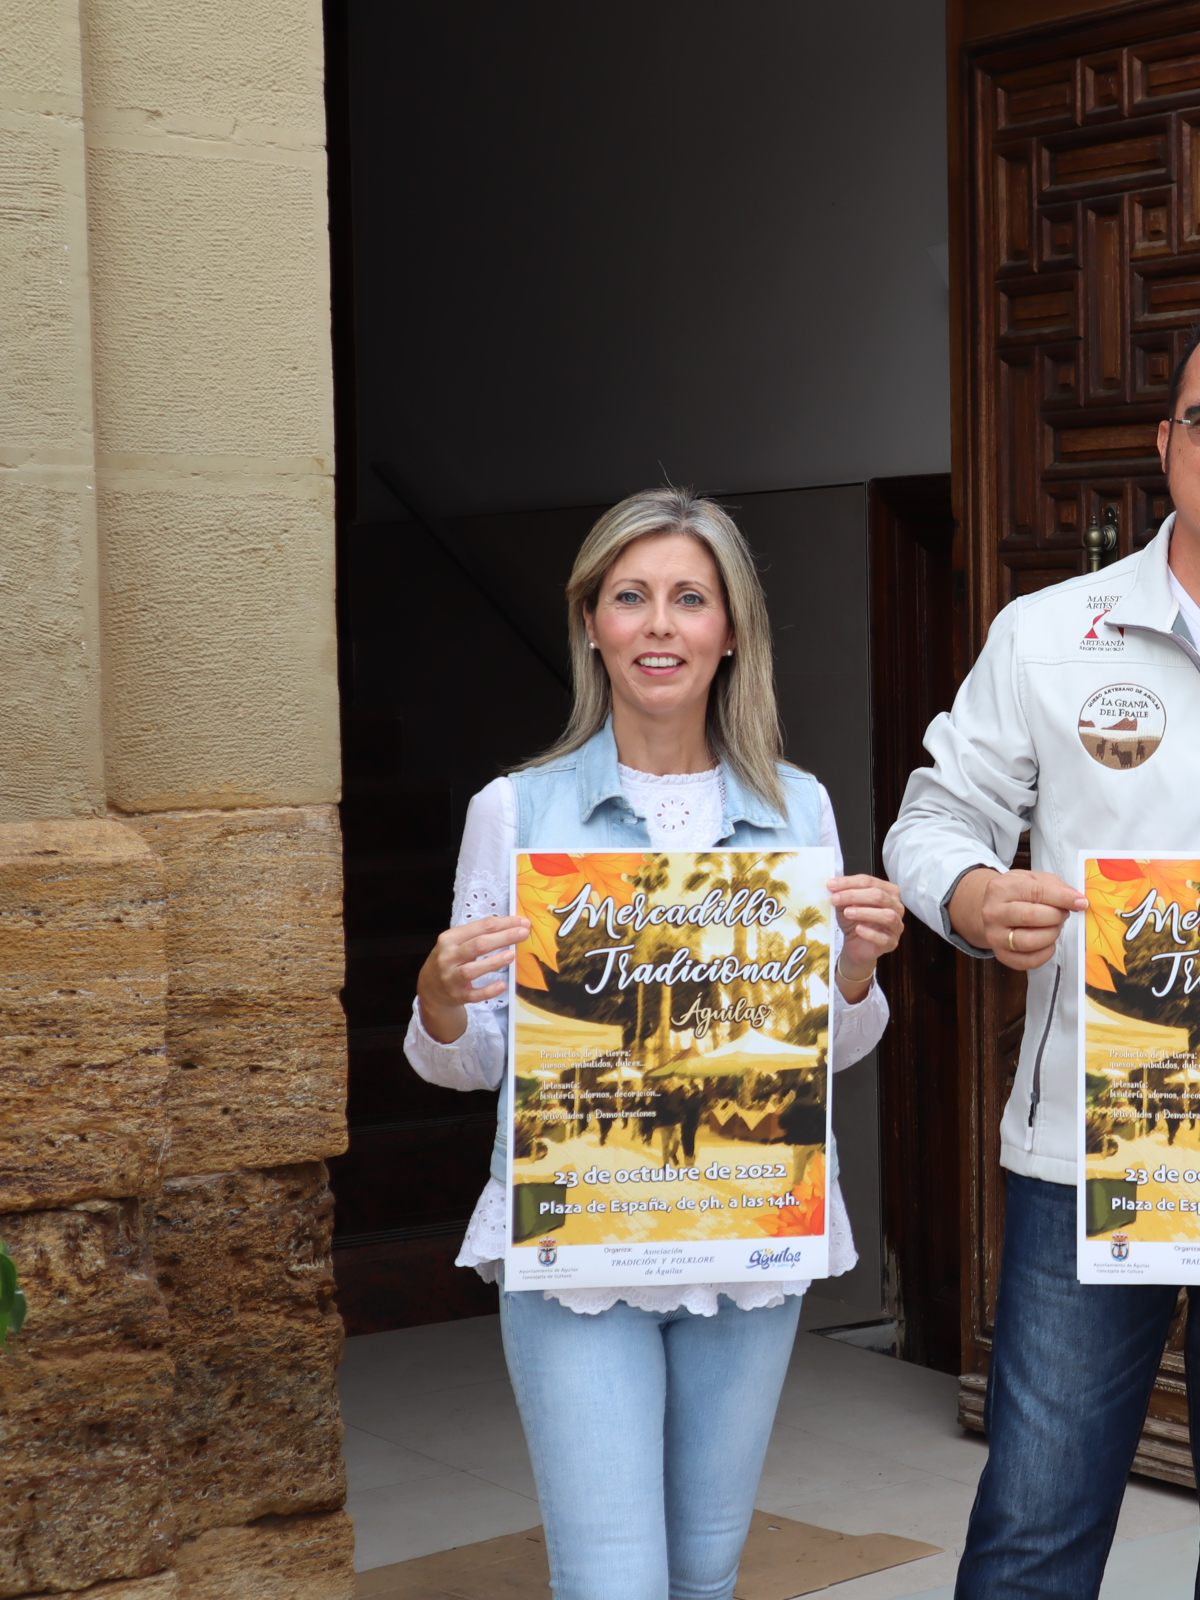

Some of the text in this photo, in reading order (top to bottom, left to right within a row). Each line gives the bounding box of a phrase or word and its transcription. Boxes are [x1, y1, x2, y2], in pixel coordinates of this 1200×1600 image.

[554, 882, 786, 939] Mercadillo
[584, 944, 808, 994] Tradicional
[671, 992, 771, 1038] Águilas
[540, 1050, 580, 1059] Productos
[583, 1049, 592, 1057] de
[595, 1049, 602, 1057] la
[1109, 1050, 1148, 1059] Productos
[1151, 1050, 1160, 1059] de
[1162, 1050, 1170, 1059] la
[587, 1113, 592, 1122] y
[1155, 1112, 1160, 1121] y
[554, 1162, 787, 1187] 23 de octubre de 2022
[1125, 1168, 1148, 1186] 23
[1153, 1165, 1179, 1183] de
[539, 1192, 800, 1215] Plaza de España, de 9h. a las 14h.
[1111, 1197, 1152, 1211] Plaza
[1156, 1198, 1175, 1211] de
[611, 1257, 656, 1266] TRADICIÓN
[655, 1267, 683, 1275] Águilas
